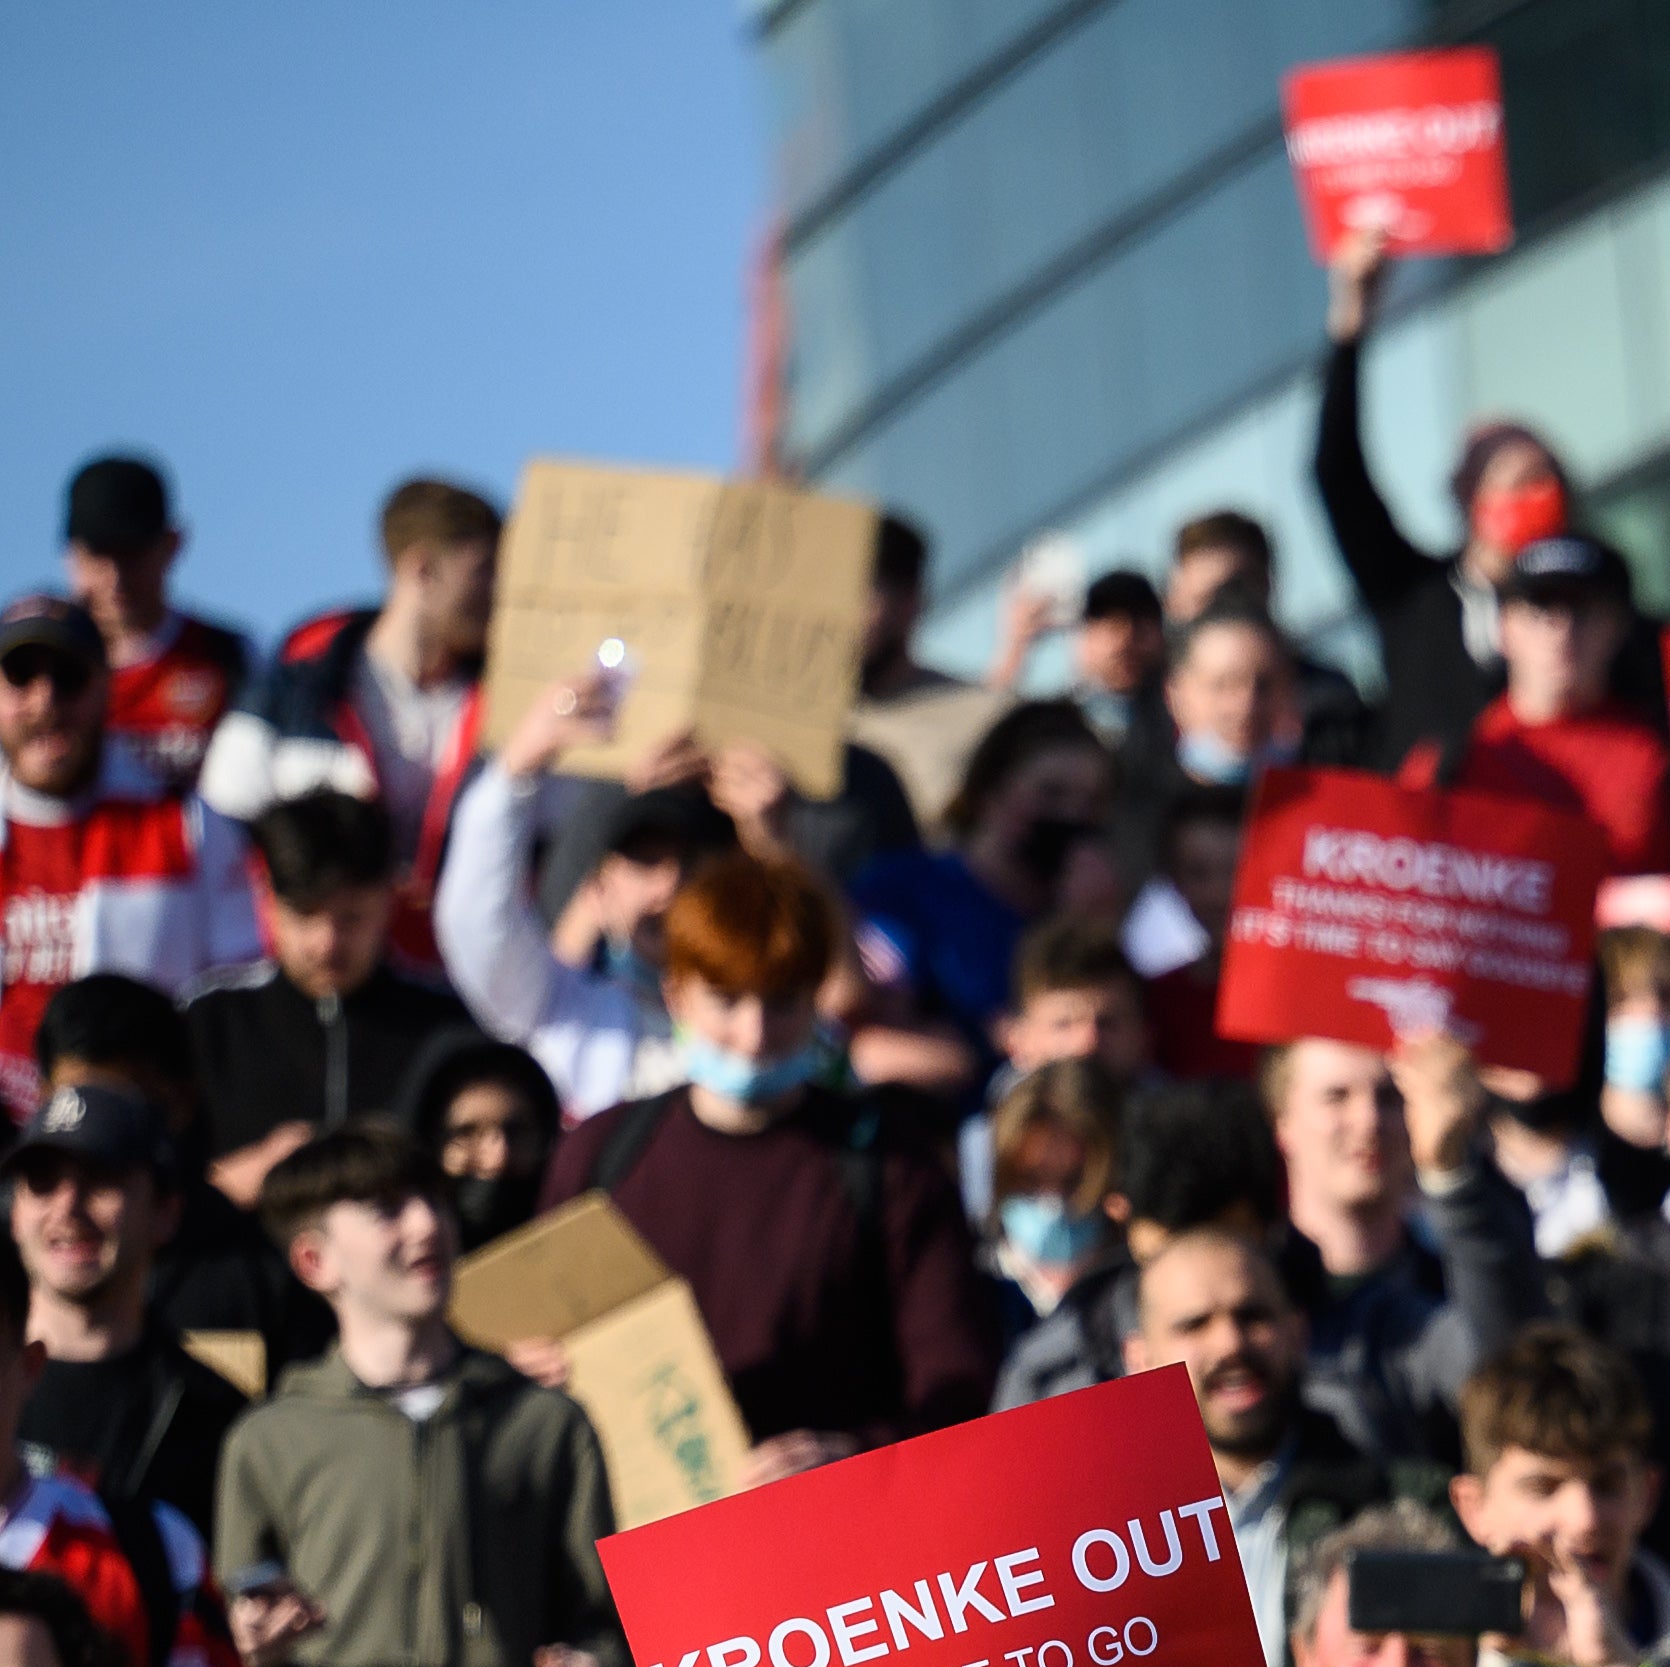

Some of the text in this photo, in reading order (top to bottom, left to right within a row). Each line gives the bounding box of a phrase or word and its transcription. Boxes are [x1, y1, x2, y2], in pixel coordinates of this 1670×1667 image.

[1303, 824, 1555, 914] KROENKE
[1071, 1496, 1224, 1592] OUT
[1087, 1616, 1159, 1667] GO
